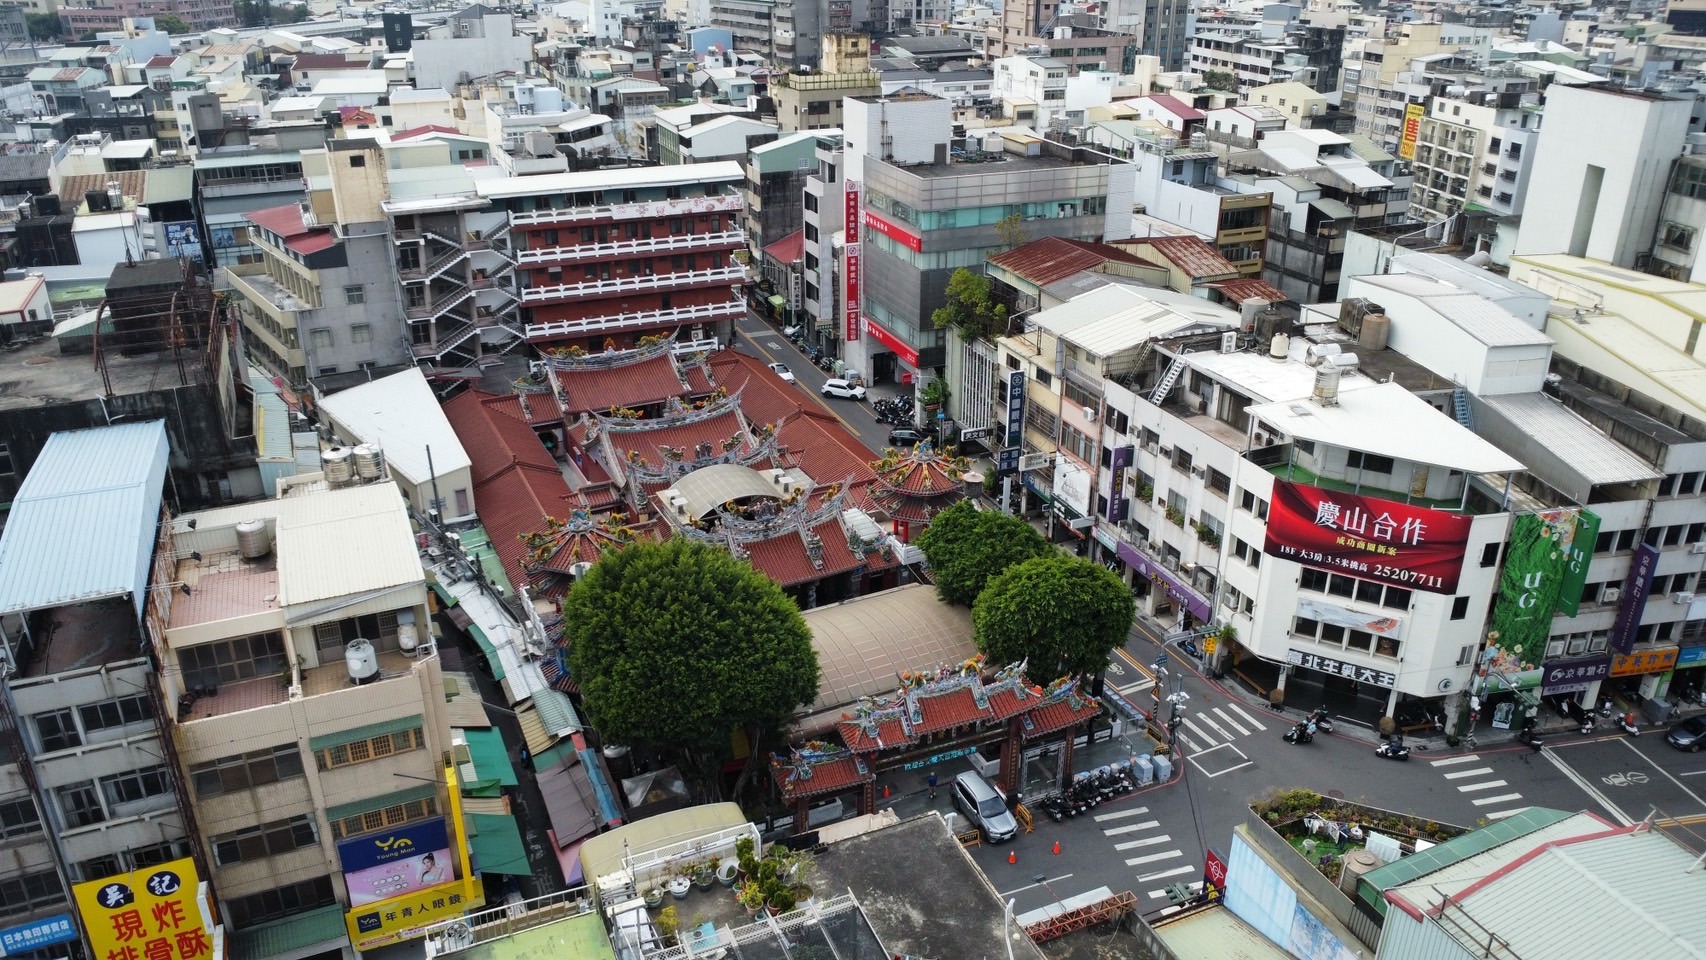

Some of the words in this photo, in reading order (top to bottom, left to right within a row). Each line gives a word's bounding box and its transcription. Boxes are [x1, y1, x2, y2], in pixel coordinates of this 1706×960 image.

[1314, 500, 1428, 546] 慶山合作
[1280, 545, 1296, 556] 18F
[1374, 564, 1443, 588] 25207711
[377, 851, 399, 860] Young
[400, 847, 416, 855] Man
[105, 874, 179, 907] 吳記
[385, 893, 462, 923] 年青人眼鏡
[109, 900, 187, 942] 現炸
